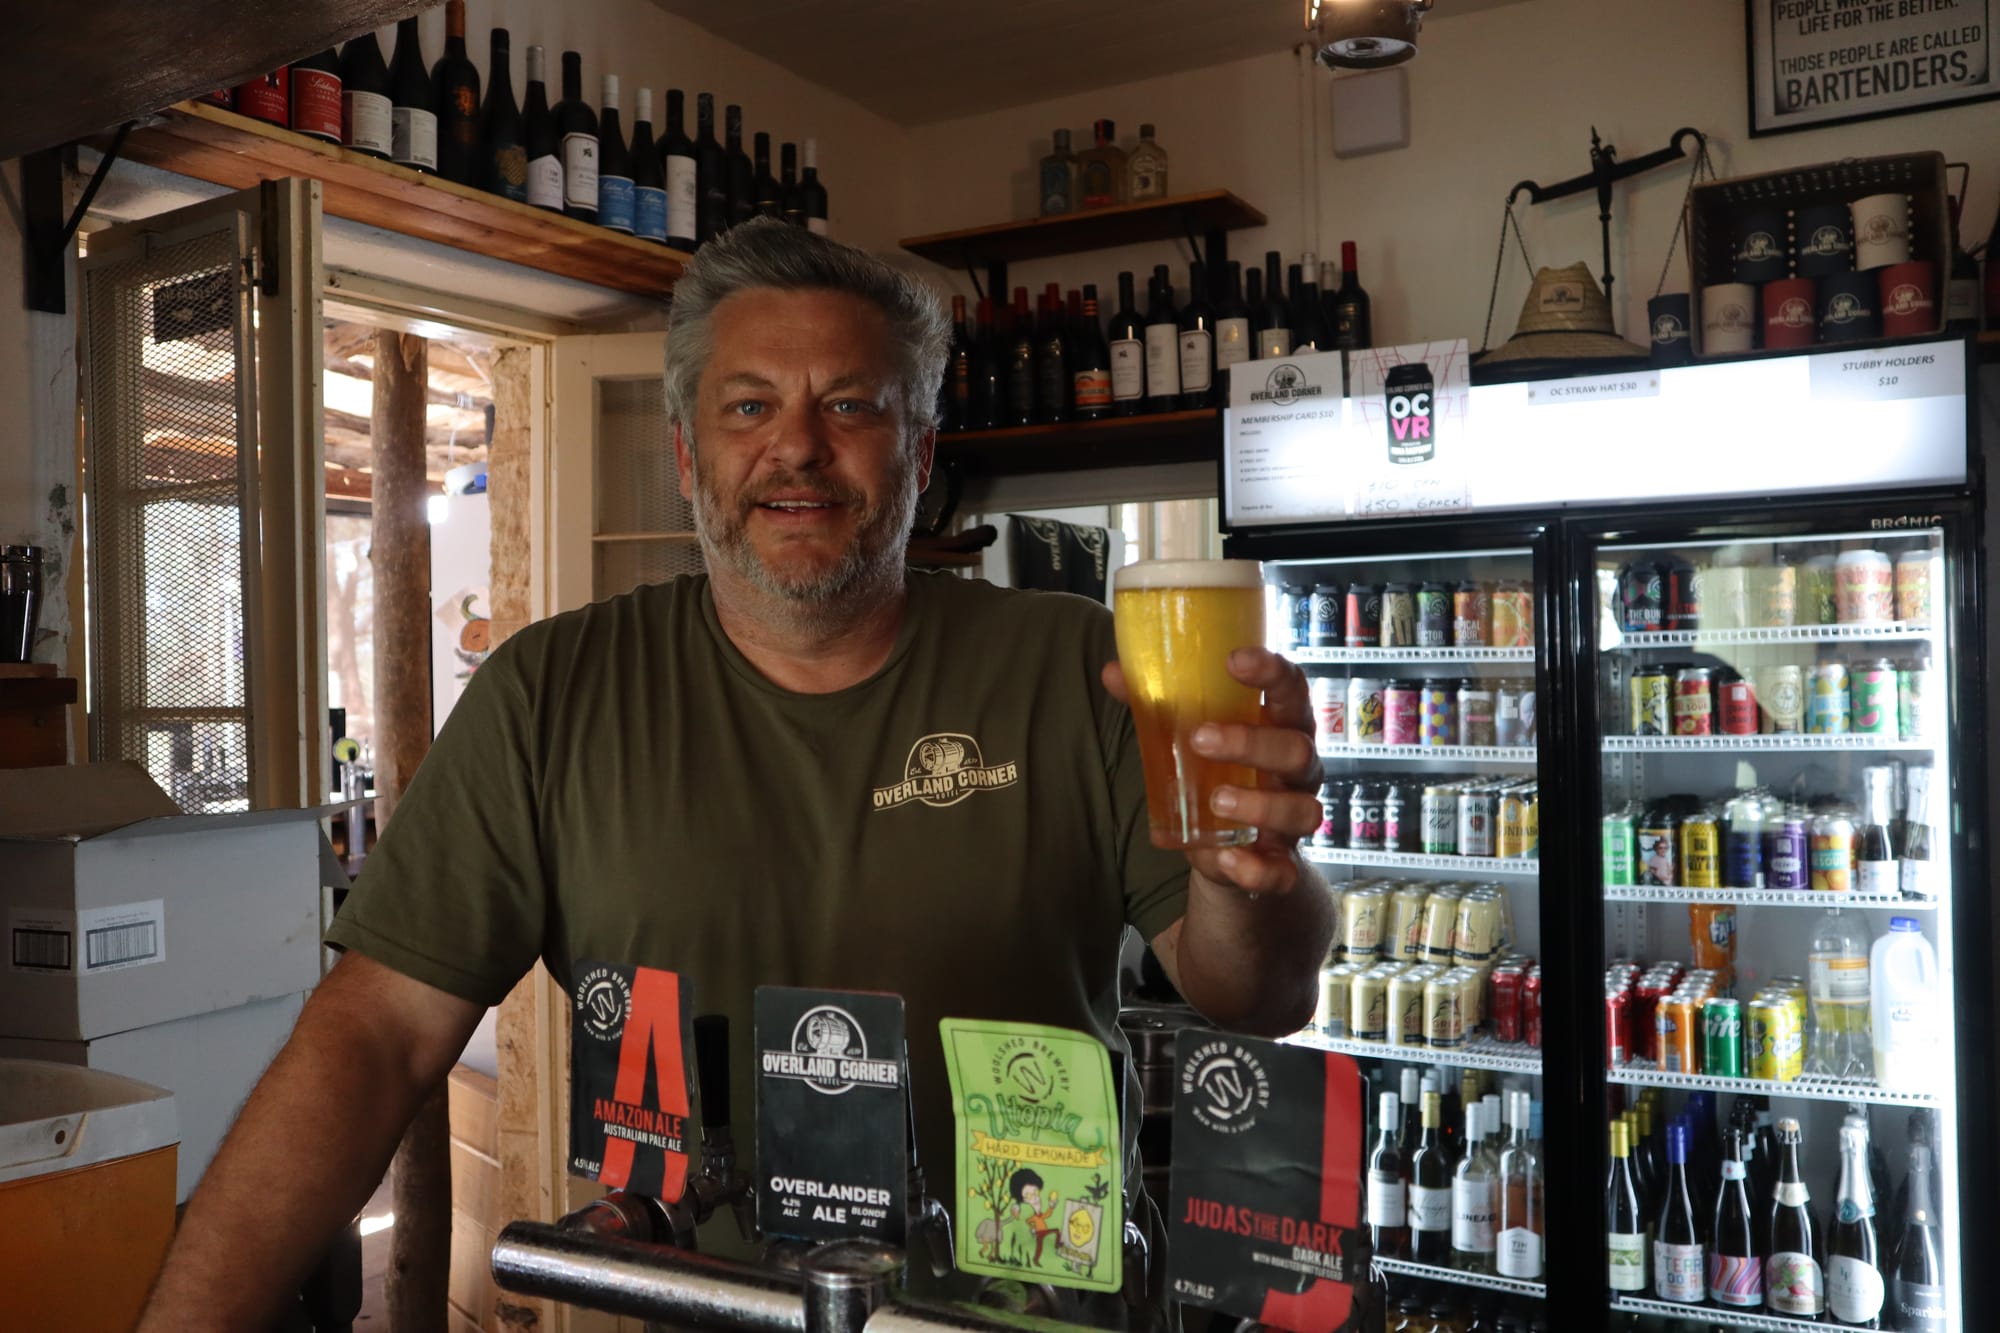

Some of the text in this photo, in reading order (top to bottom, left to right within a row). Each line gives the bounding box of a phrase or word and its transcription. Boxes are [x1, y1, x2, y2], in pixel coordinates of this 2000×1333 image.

[1777, 0, 1832, 20] PEOPLE
[1799, 15, 1830, 36] LIFE
[1833, 9, 1863, 29] FOR
[1867, 4, 1894, 24] THE
[1780, 25, 1981, 75] THOSE PEOPLE ARE CALLED
[1786, 50, 1977, 109] BARTENDERS.
[1842, 355, 1935, 372] STUBBY HOLDERS
[1251, 385, 1322, 402] OVERLAND CORNER
[1550, 387, 1563, 397] OC
[1565, 385, 1598, 396] STRAW
[1600, 383, 1618, 394] HAT
[1879, 375, 1899, 387] $10
[1241, 413, 1293, 424] MEMBERSHIP
[1295, 411, 1318, 420] CARD
[1391, 394, 1430, 419] OC
[1391, 415, 1430, 440] VR
[1365, 498, 1400, 511] $50
[873, 764, 1018, 807] OVERLAND CORNER
[1350, 806, 1379, 823] OC
[577, 968, 633, 1021] WOOLSHED BREWERY
[763, 1054, 898, 1083] OVERLAND CORNER
[1182, 1041, 1270, 1109] WOOLSHED BREWERY
[594, 1098, 682, 1138] AMAZON ALE
[603, 1123, 682, 1152] AUSTRALIAN PALE ALE
[986, 1142, 1091, 1164] HARD LEMONADE
[770, 1176, 891, 1206] OVERLANDER
[783, 1207, 799, 1217] ALC
[812, 1205, 847, 1224] ALE
[851, 1206, 886, 1219] BLONDE
[861, 1217, 877, 1228] ALE
[1183, 1197, 1343, 1254] JUDAS THE DARK
[1292, 1246, 1343, 1271] DARK ALE
